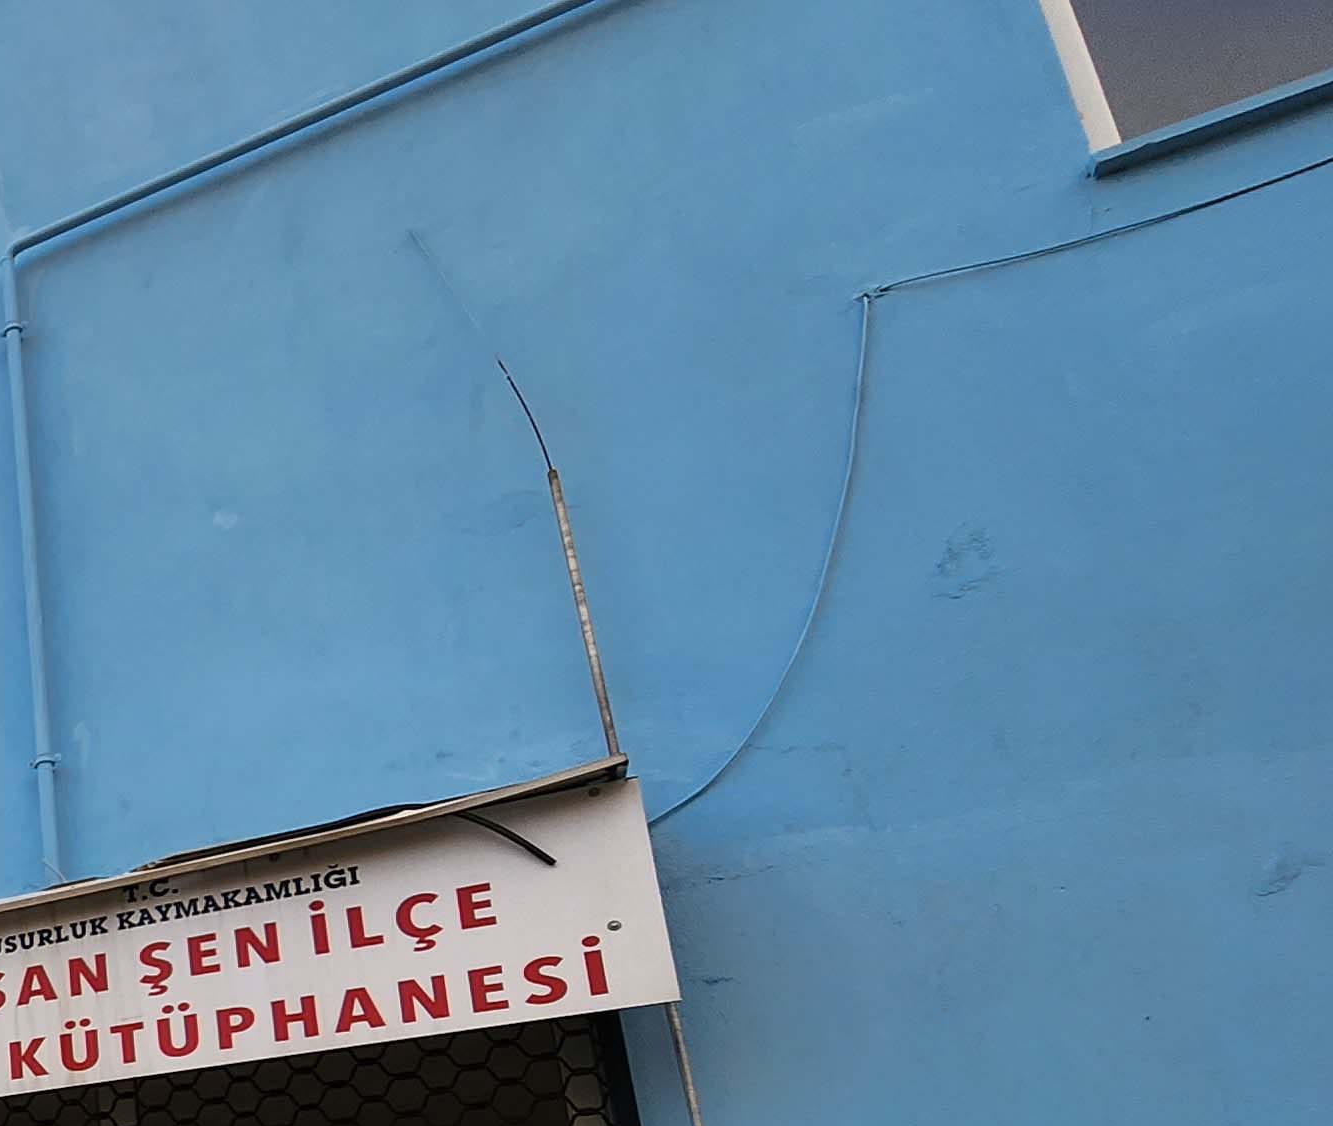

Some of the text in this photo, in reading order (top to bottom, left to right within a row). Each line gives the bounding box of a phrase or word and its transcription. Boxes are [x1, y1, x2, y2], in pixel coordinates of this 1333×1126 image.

[117, 864, 361, 931] KAYMAKAMLIĞI
[123, 877, 179, 904] T.C.
[138, 921, 281, 997] ŞEN
[308, 881, 498, 956] İLÇE
[9, 935, 610, 1083] KÜTÜPHANESİ
